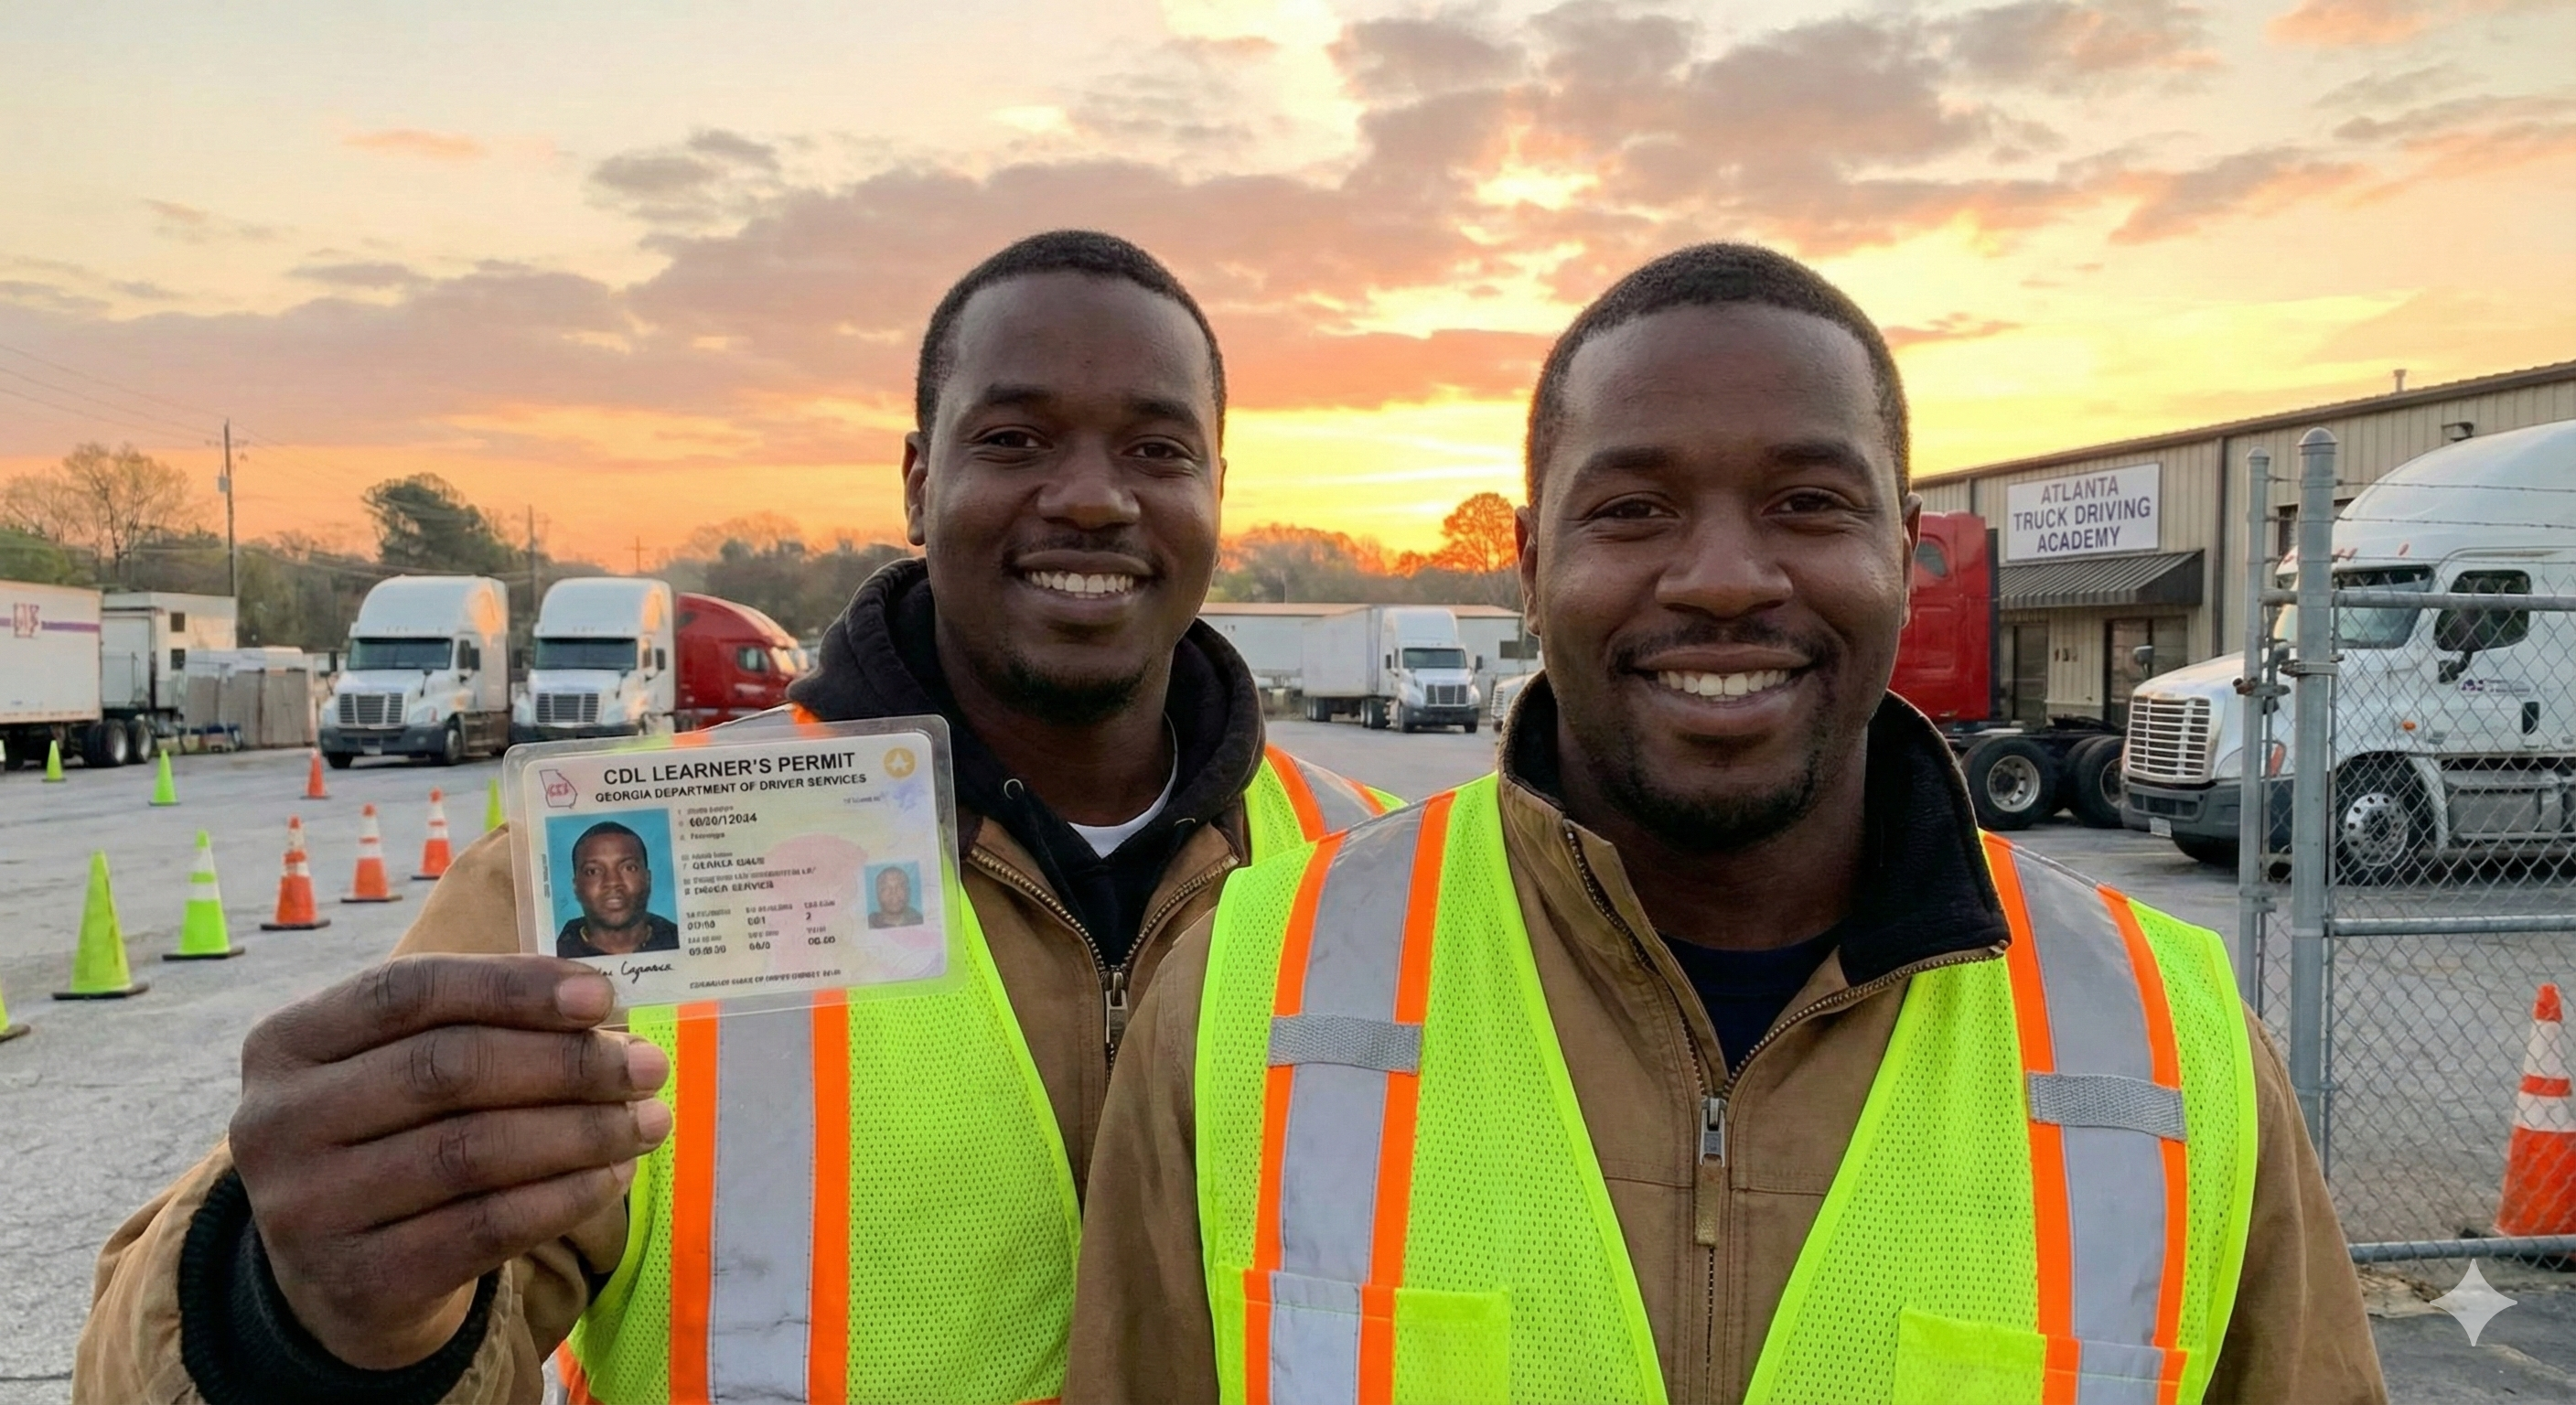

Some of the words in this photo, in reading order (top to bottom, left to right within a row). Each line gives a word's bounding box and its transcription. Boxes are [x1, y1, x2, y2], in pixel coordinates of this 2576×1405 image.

[2041, 476, 2119, 504] ATLANTA
[2013, 506, 2068, 531] TRUCK
[2075, 497, 2151, 525] DRIVING
[2037, 526, 2120, 552] ACADEMY
[604, 767, 647, 785] CDL
[652, 758, 772, 782] LEARNER'S
[778, 752, 855, 773] PERMIT
[595, 789, 652, 803] GEORGIA
[655, 783, 736, 799] DEPARTMENT
[740, 781, 756, 792] OF
[759, 778, 804, 791] DRIVER
